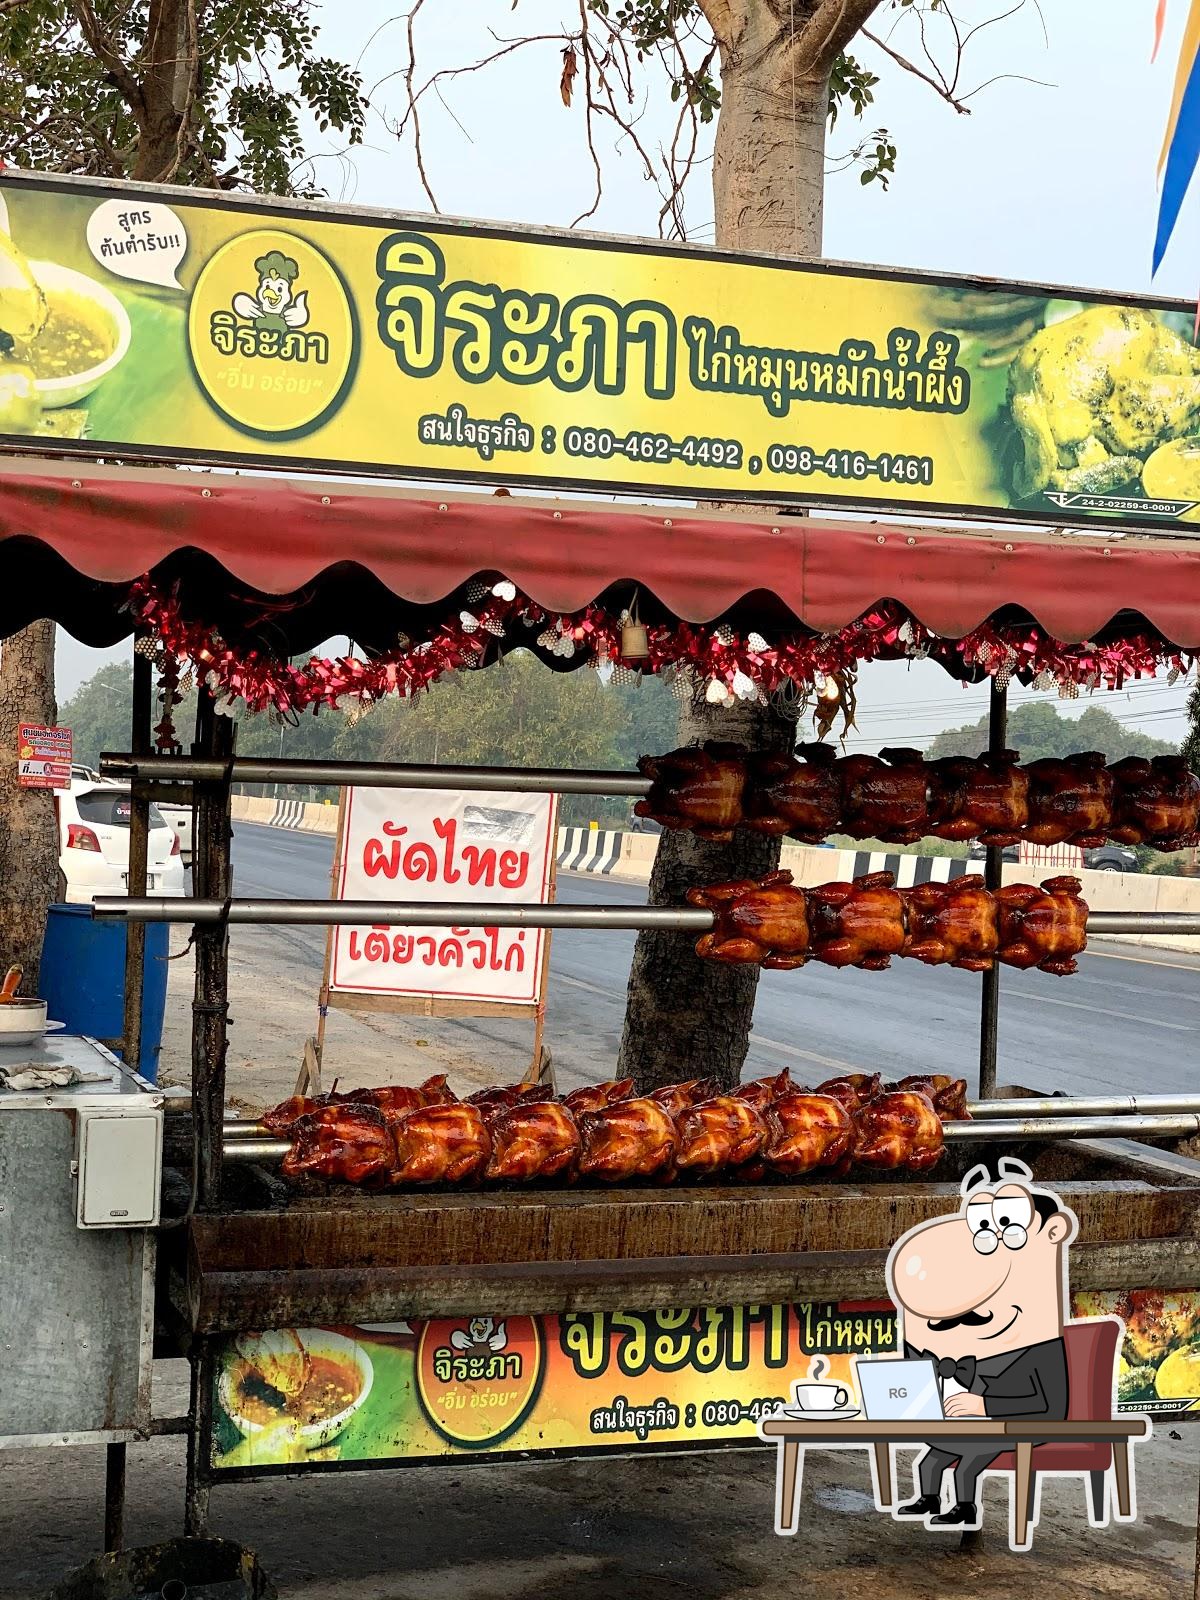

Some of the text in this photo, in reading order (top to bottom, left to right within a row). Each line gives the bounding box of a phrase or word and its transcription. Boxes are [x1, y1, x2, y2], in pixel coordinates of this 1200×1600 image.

[117, 210, 152, 233] สูตร
[100, 232, 180, 257] ต้นตำรับ!!
[212, 312, 327, 362] จิระภา
[380, 237, 965, 411] จิระภา ไก่หมุนหมักน้ำผึ้ง
[422, 407, 531, 456] สนใจธุรกิจ
[566, 429, 740, 466] 080-462-4492
[770, 448, 932, 482] 098-416-1461
[1081, 498, 1177, 513] 24-2-02259-6-0001
[363, 817, 530, 889] ผัดไทย
[434, 1348, 521, 1381] จิระภา
[592, 1400, 677, 1437] สนใจธุรกิจ
